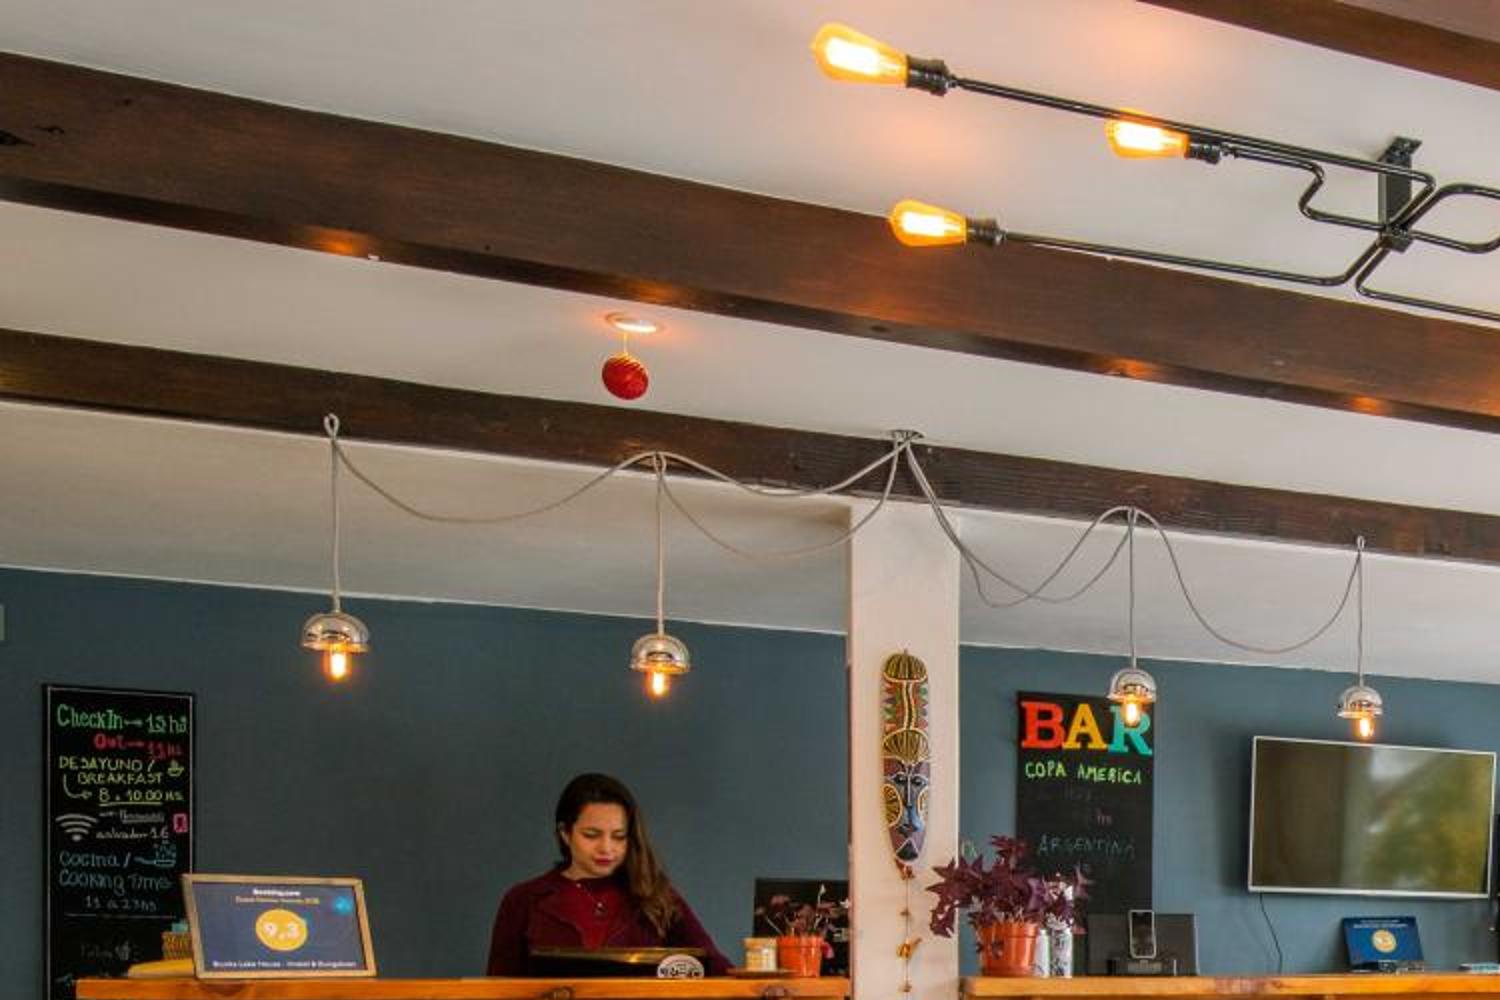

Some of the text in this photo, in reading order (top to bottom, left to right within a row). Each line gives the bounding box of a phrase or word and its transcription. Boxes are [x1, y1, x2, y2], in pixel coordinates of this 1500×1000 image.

[1021, 701, 1152, 755] BAR
[77, 772, 164, 785] BREAKFAST
[1025, 761, 1067, 779] COPA
